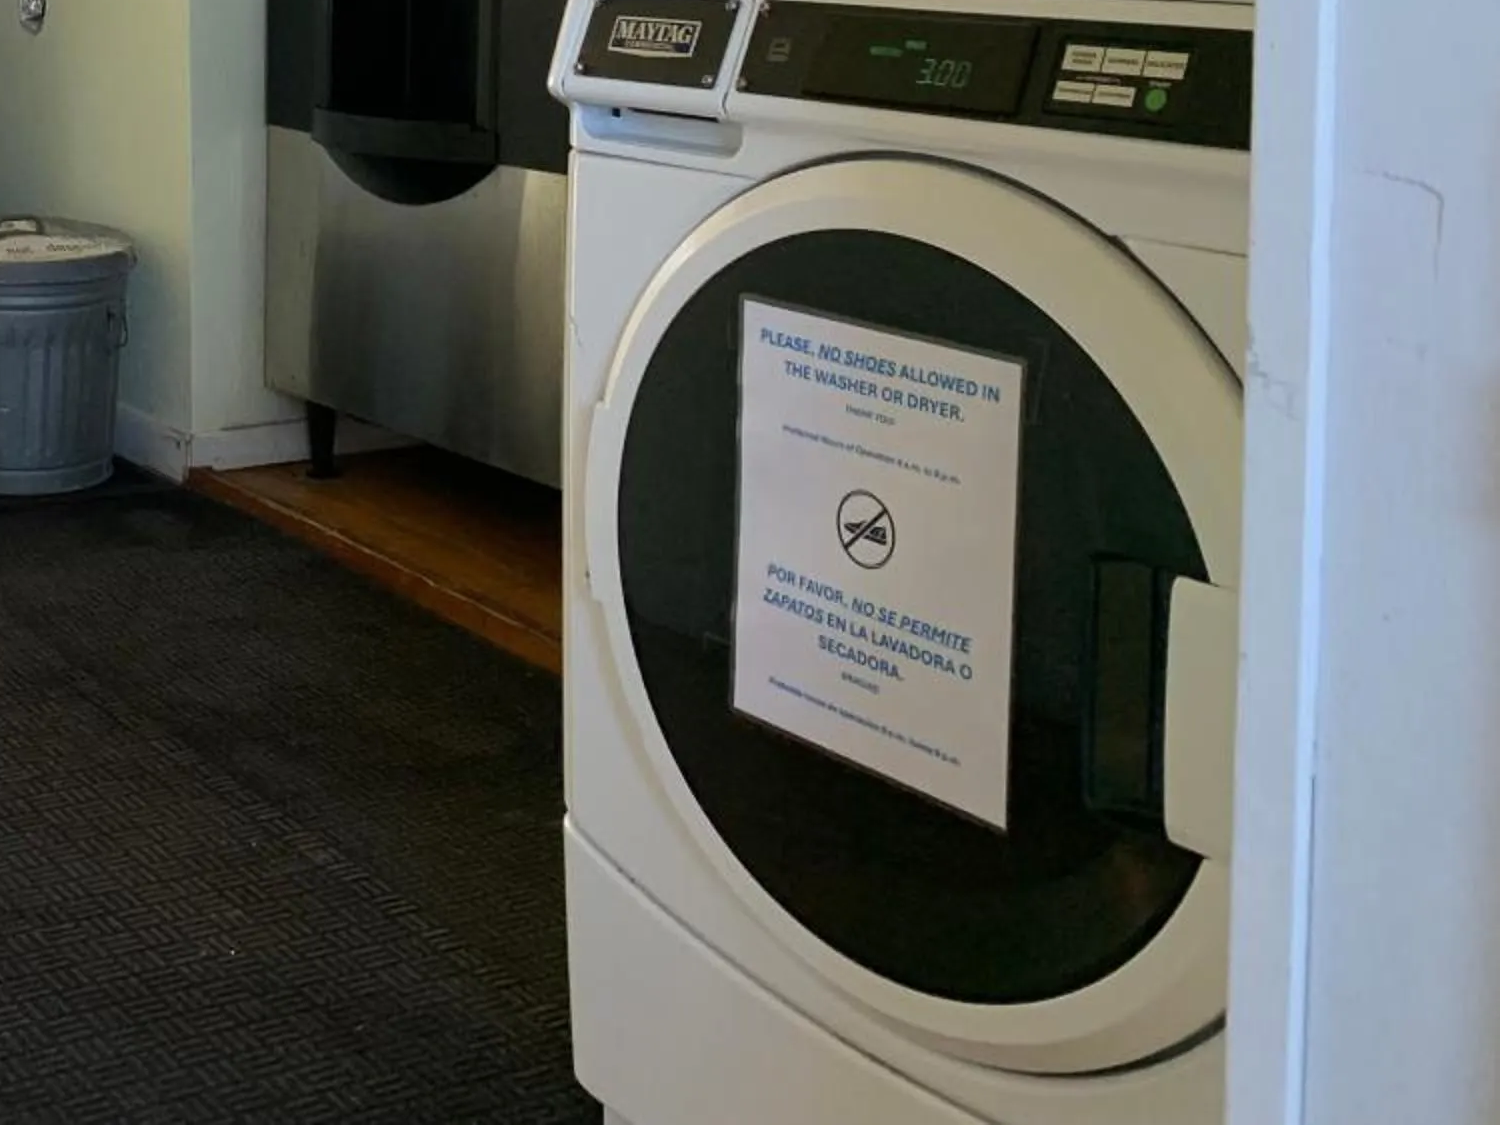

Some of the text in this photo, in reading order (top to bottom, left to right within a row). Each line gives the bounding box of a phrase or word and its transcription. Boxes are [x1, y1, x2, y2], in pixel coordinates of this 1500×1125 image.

[614, 21, 693, 43] MAYTAG
[784, 360, 811, 380] THE
[816, 369, 878, 398] WASHER
[882, 387, 904, 405] OR
[907, 394, 965, 422] DRYER.
[818, 343, 841, 365] NO
[843, 350, 896, 376] SHOES
[900, 365, 978, 396] ALLOWED
[981, 387, 1000, 402] IN
[763, 588, 973, 680] ZAPATOS EN LA LAVADORA O
[767, 564, 796, 587] POR
[852, 597, 874, 618] NO
[878, 606, 897, 625] SE
[900, 615, 972, 654] PERMITE
